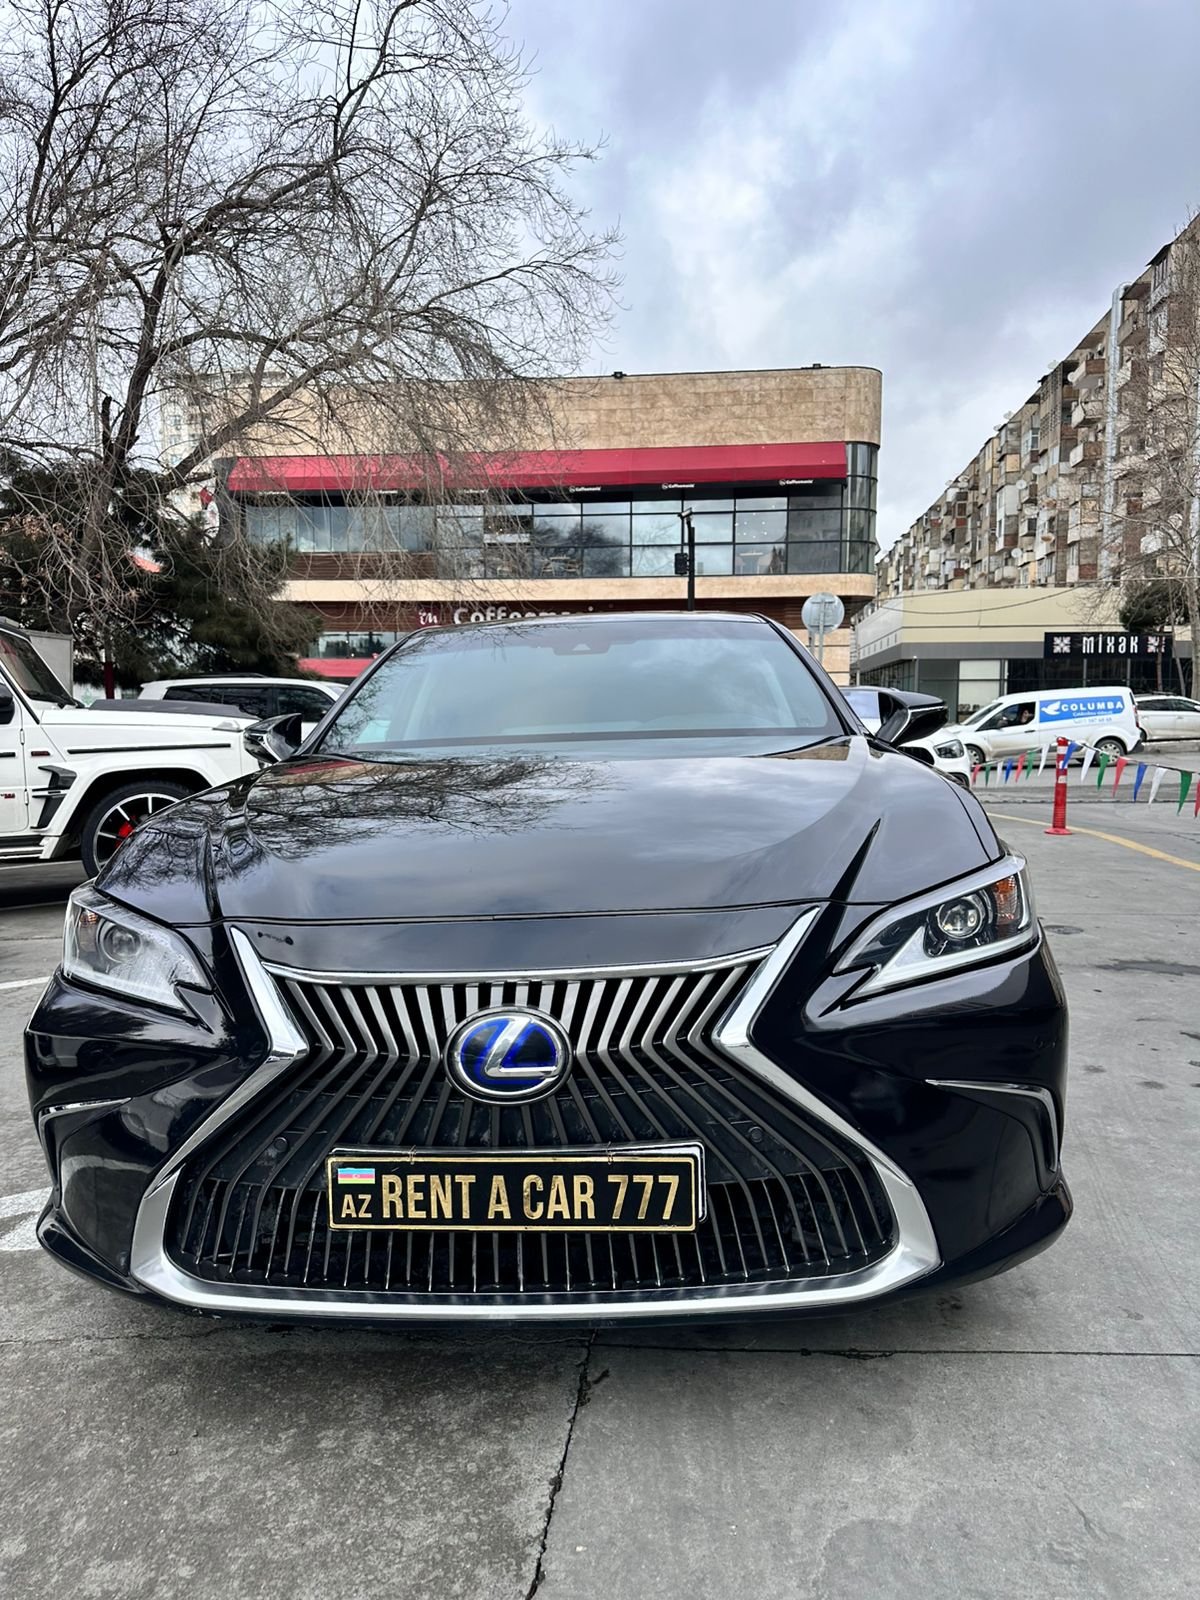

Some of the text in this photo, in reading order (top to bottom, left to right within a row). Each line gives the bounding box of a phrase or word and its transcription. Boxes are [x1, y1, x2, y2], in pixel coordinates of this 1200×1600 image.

[1061, 701, 1123, 712] COLUMBA
[341, 1195, 372, 1218] AZ
[381, 1175, 680, 1219] RENT A CAR 777
